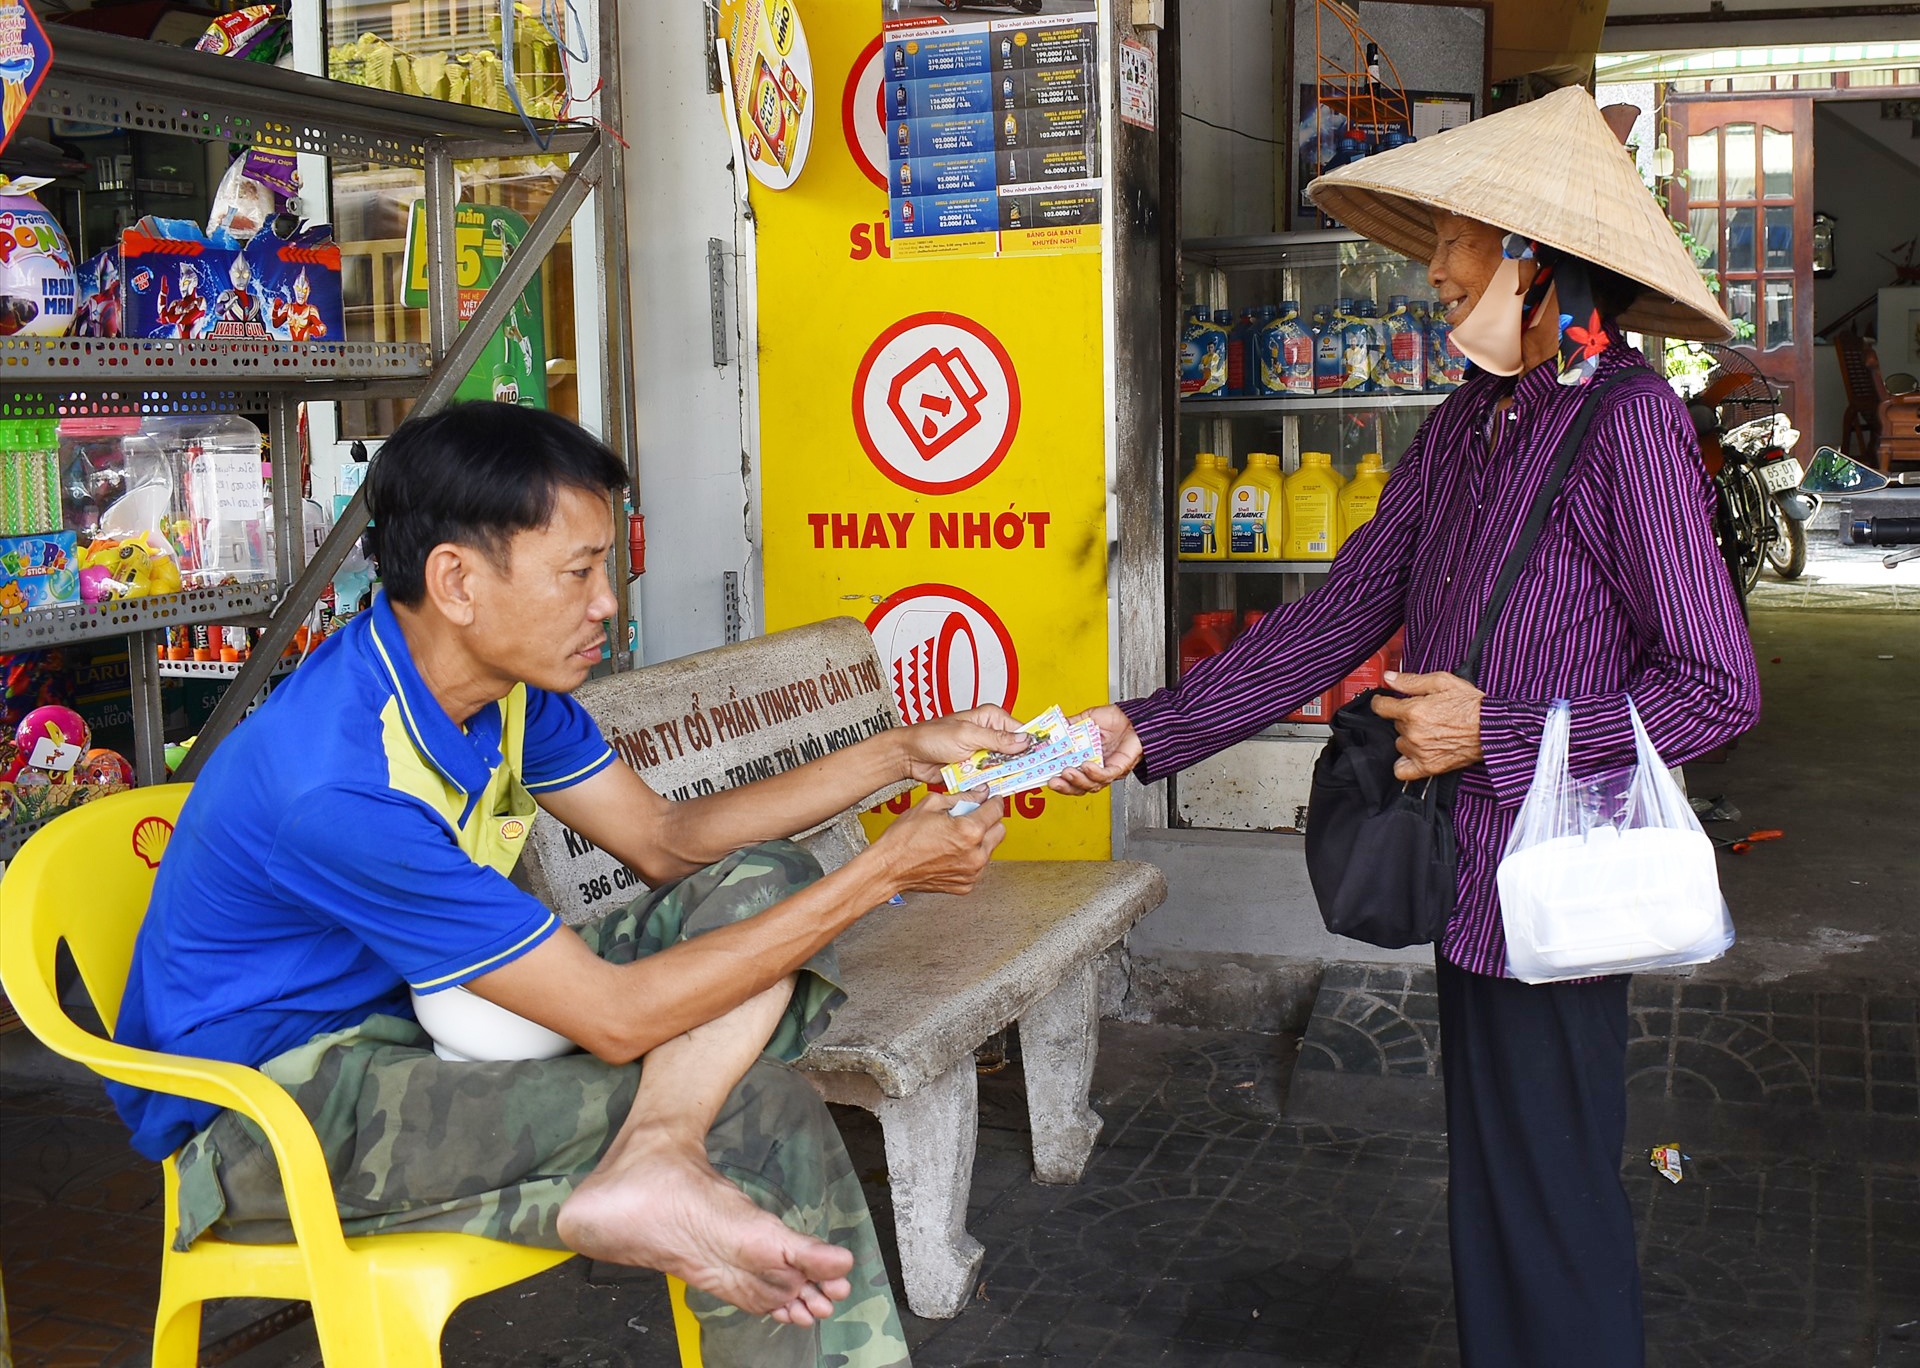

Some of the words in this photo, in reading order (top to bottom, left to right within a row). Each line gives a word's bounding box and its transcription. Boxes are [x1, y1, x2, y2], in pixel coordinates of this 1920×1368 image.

[778, 6, 790, 50] HMO
[254, 154, 276, 163] Jackfruit
[458, 208, 484, 224] năm
[42, 278, 74, 296] IRON
[44, 298, 74, 315] MAN
[215, 322, 244, 336] WATER
[245, 322, 264, 336] GUN
[496, 391, 517, 402] MILO
[1767, 462, 1794, 478] 65-01
[808, 513, 914, 549] THAY
[930, 503, 1050, 550] NHỚT
[27, 568, 47, 576] STICK
[76, 664, 128, 684] LARU
[104, 704, 119, 713] BIA
[606, 727, 661, 771] ÔNG
[654, 720, 684, 760] TY
[683, 692, 712, 752] CỔ
[710, 686, 760, 743] PHẦN
[755, 679, 823, 726] VINAFOR
[820, 658, 854, 706] CẦN
[848, 654, 881, 696] THƠ
[725, 754, 776, 788] TRANG
[774, 739, 800, 772] TRÍ
[862, 704, 894, 736] THẤT
[578, 875, 612, 904] 386
